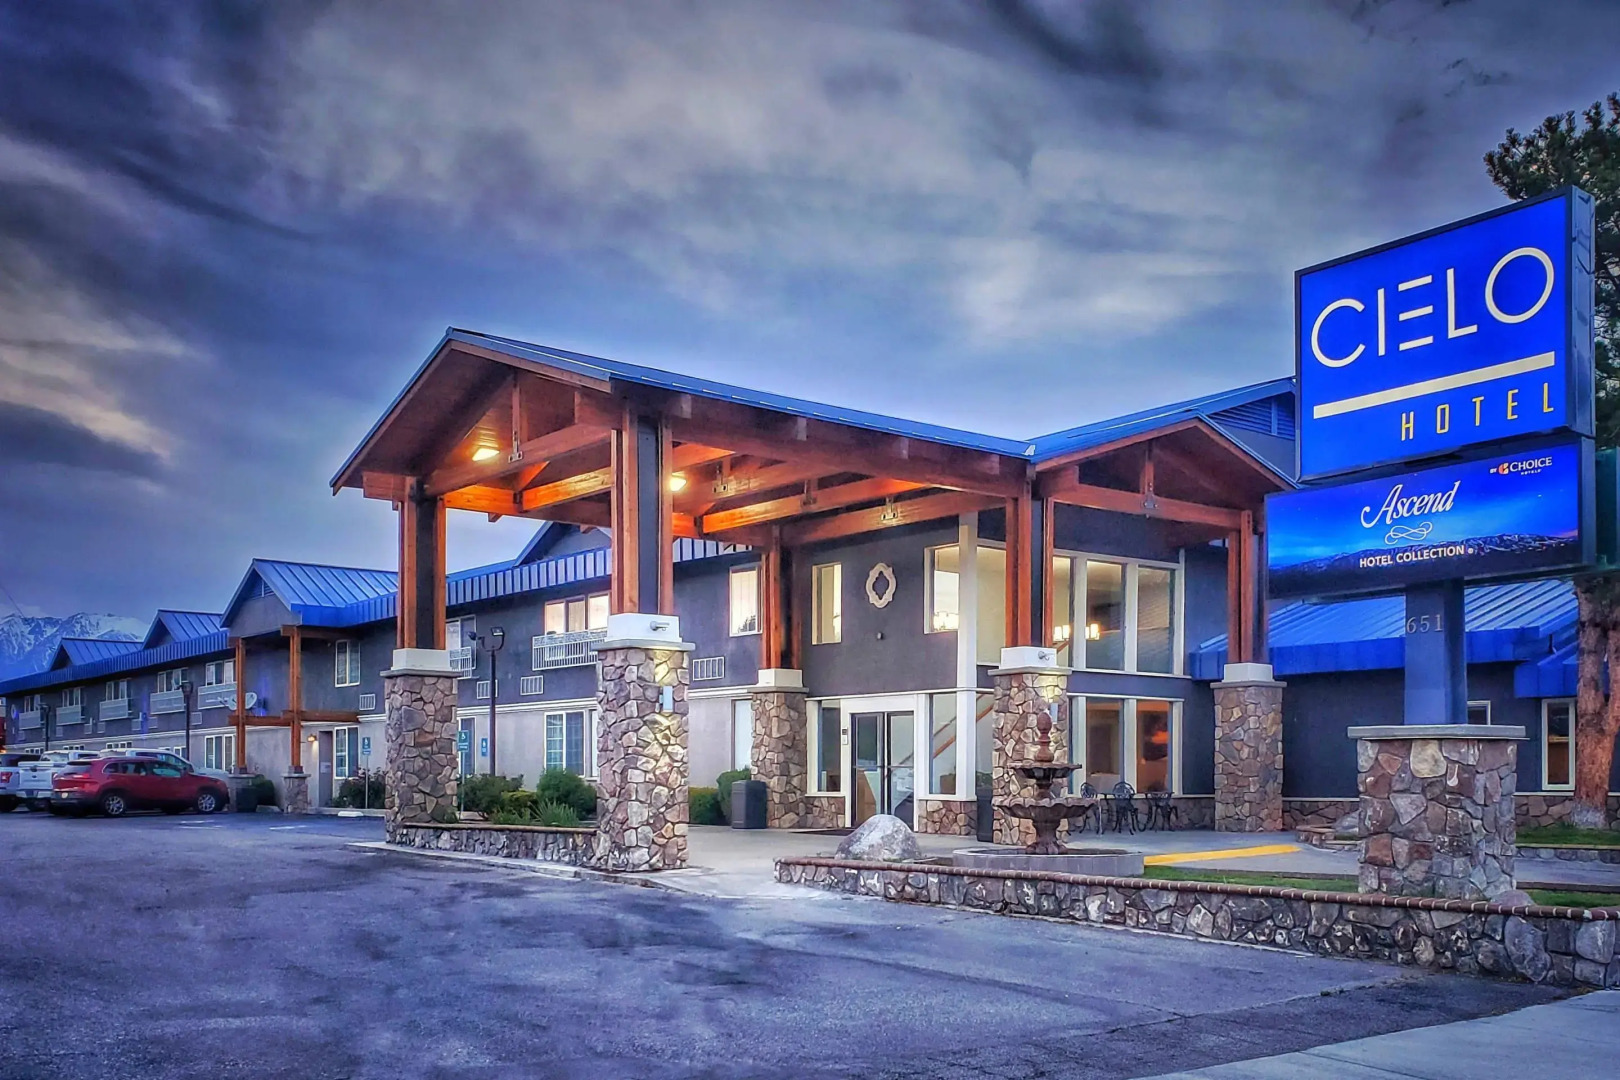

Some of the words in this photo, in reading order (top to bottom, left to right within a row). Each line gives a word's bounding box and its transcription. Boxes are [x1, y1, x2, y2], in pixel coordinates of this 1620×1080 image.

[1311, 247, 1554, 368] CIELO
[1401, 382, 1554, 441] HOTEL
[1509, 456, 1553, 472] CHOICE
[1360, 480, 1461, 528] Ascend
[1359, 555, 1393, 568] HOTEL
[1396, 545, 1465, 563] COLLECTION
[1406, 614, 1443, 634] 651
